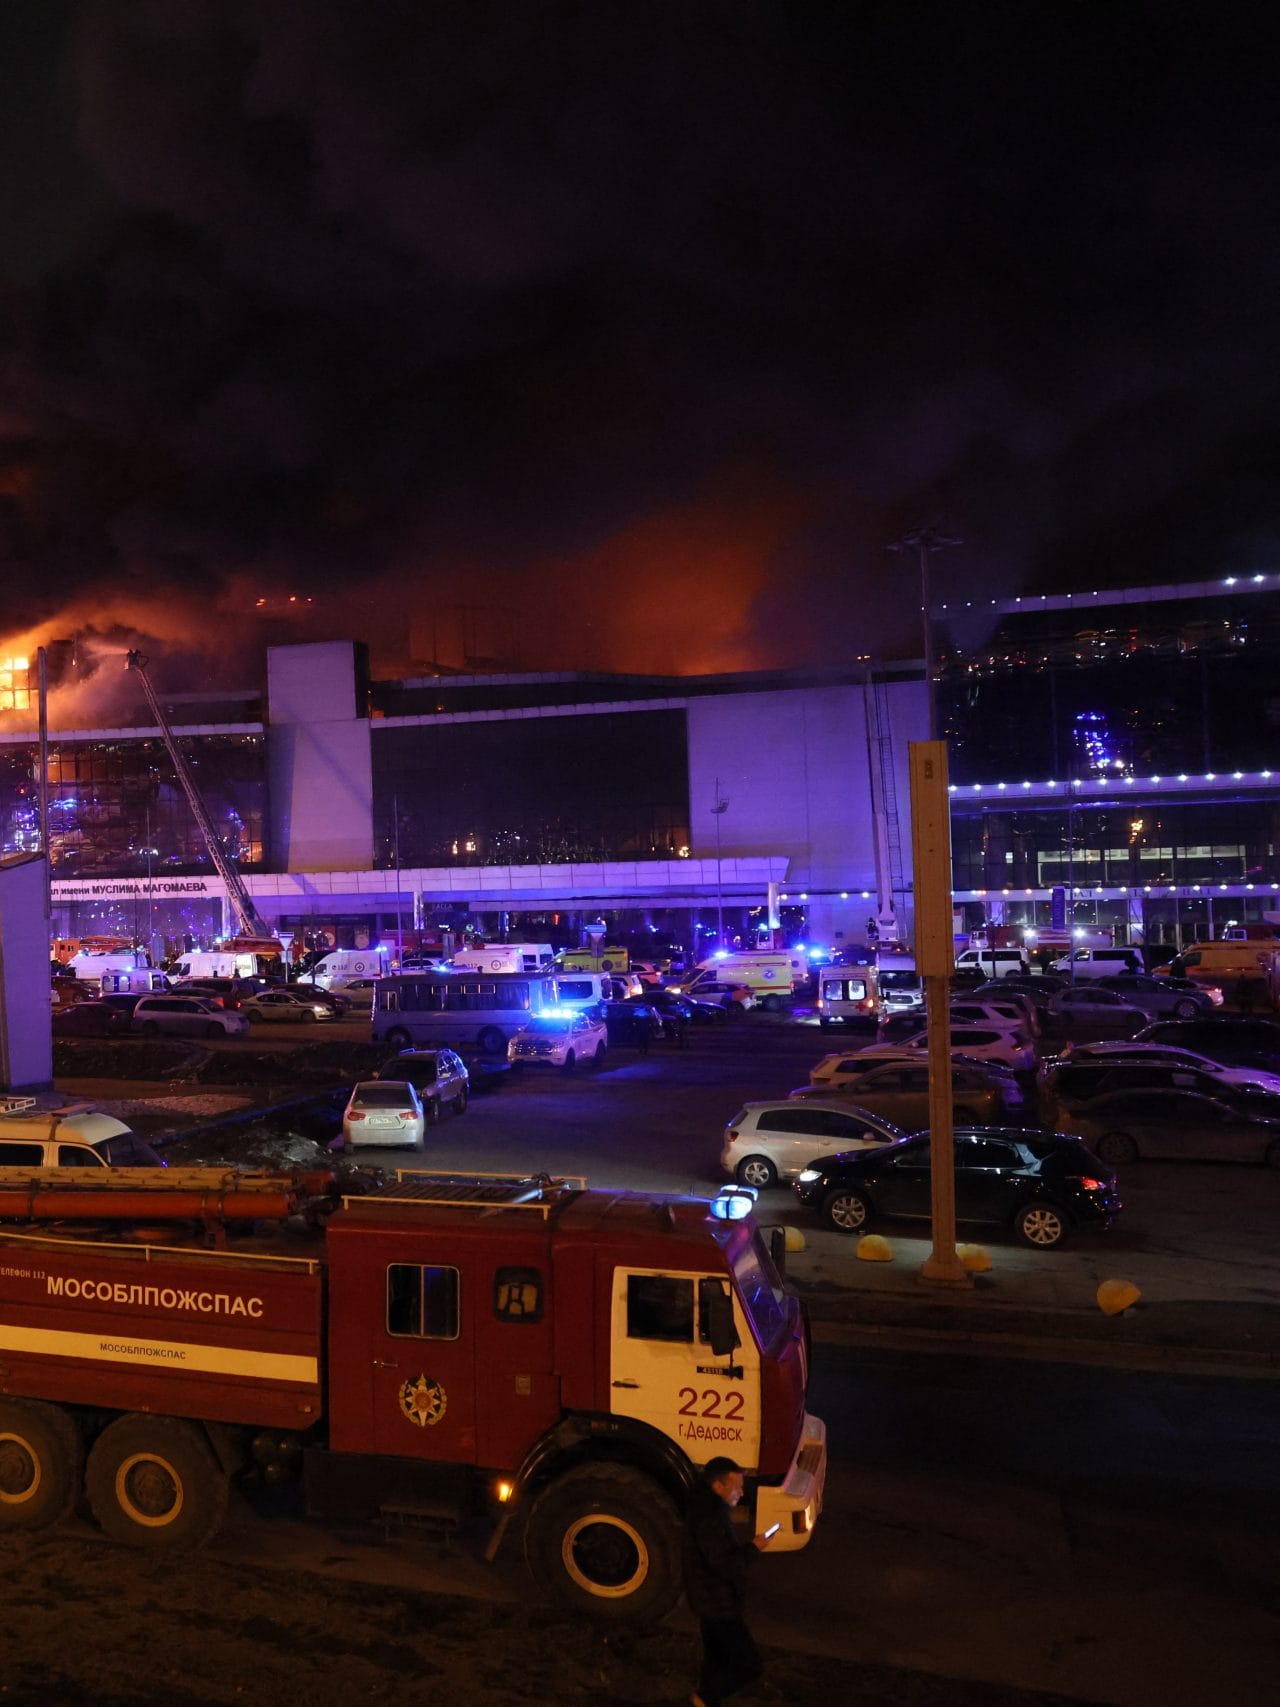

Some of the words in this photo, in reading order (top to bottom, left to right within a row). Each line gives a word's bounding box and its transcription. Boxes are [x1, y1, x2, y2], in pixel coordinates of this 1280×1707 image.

[92, 884, 140, 894] МУСЛИМА
[143, 882, 208, 893] МАГОМАЕВА
[33, 1271, 46, 1279] 112
[47, 1276, 263, 1317] МОСОБЛПОЖСПАС
[100, 1343, 186, 1360] МОСОБЛПОЖСПАС
[678, 1387, 745, 1421] 222
